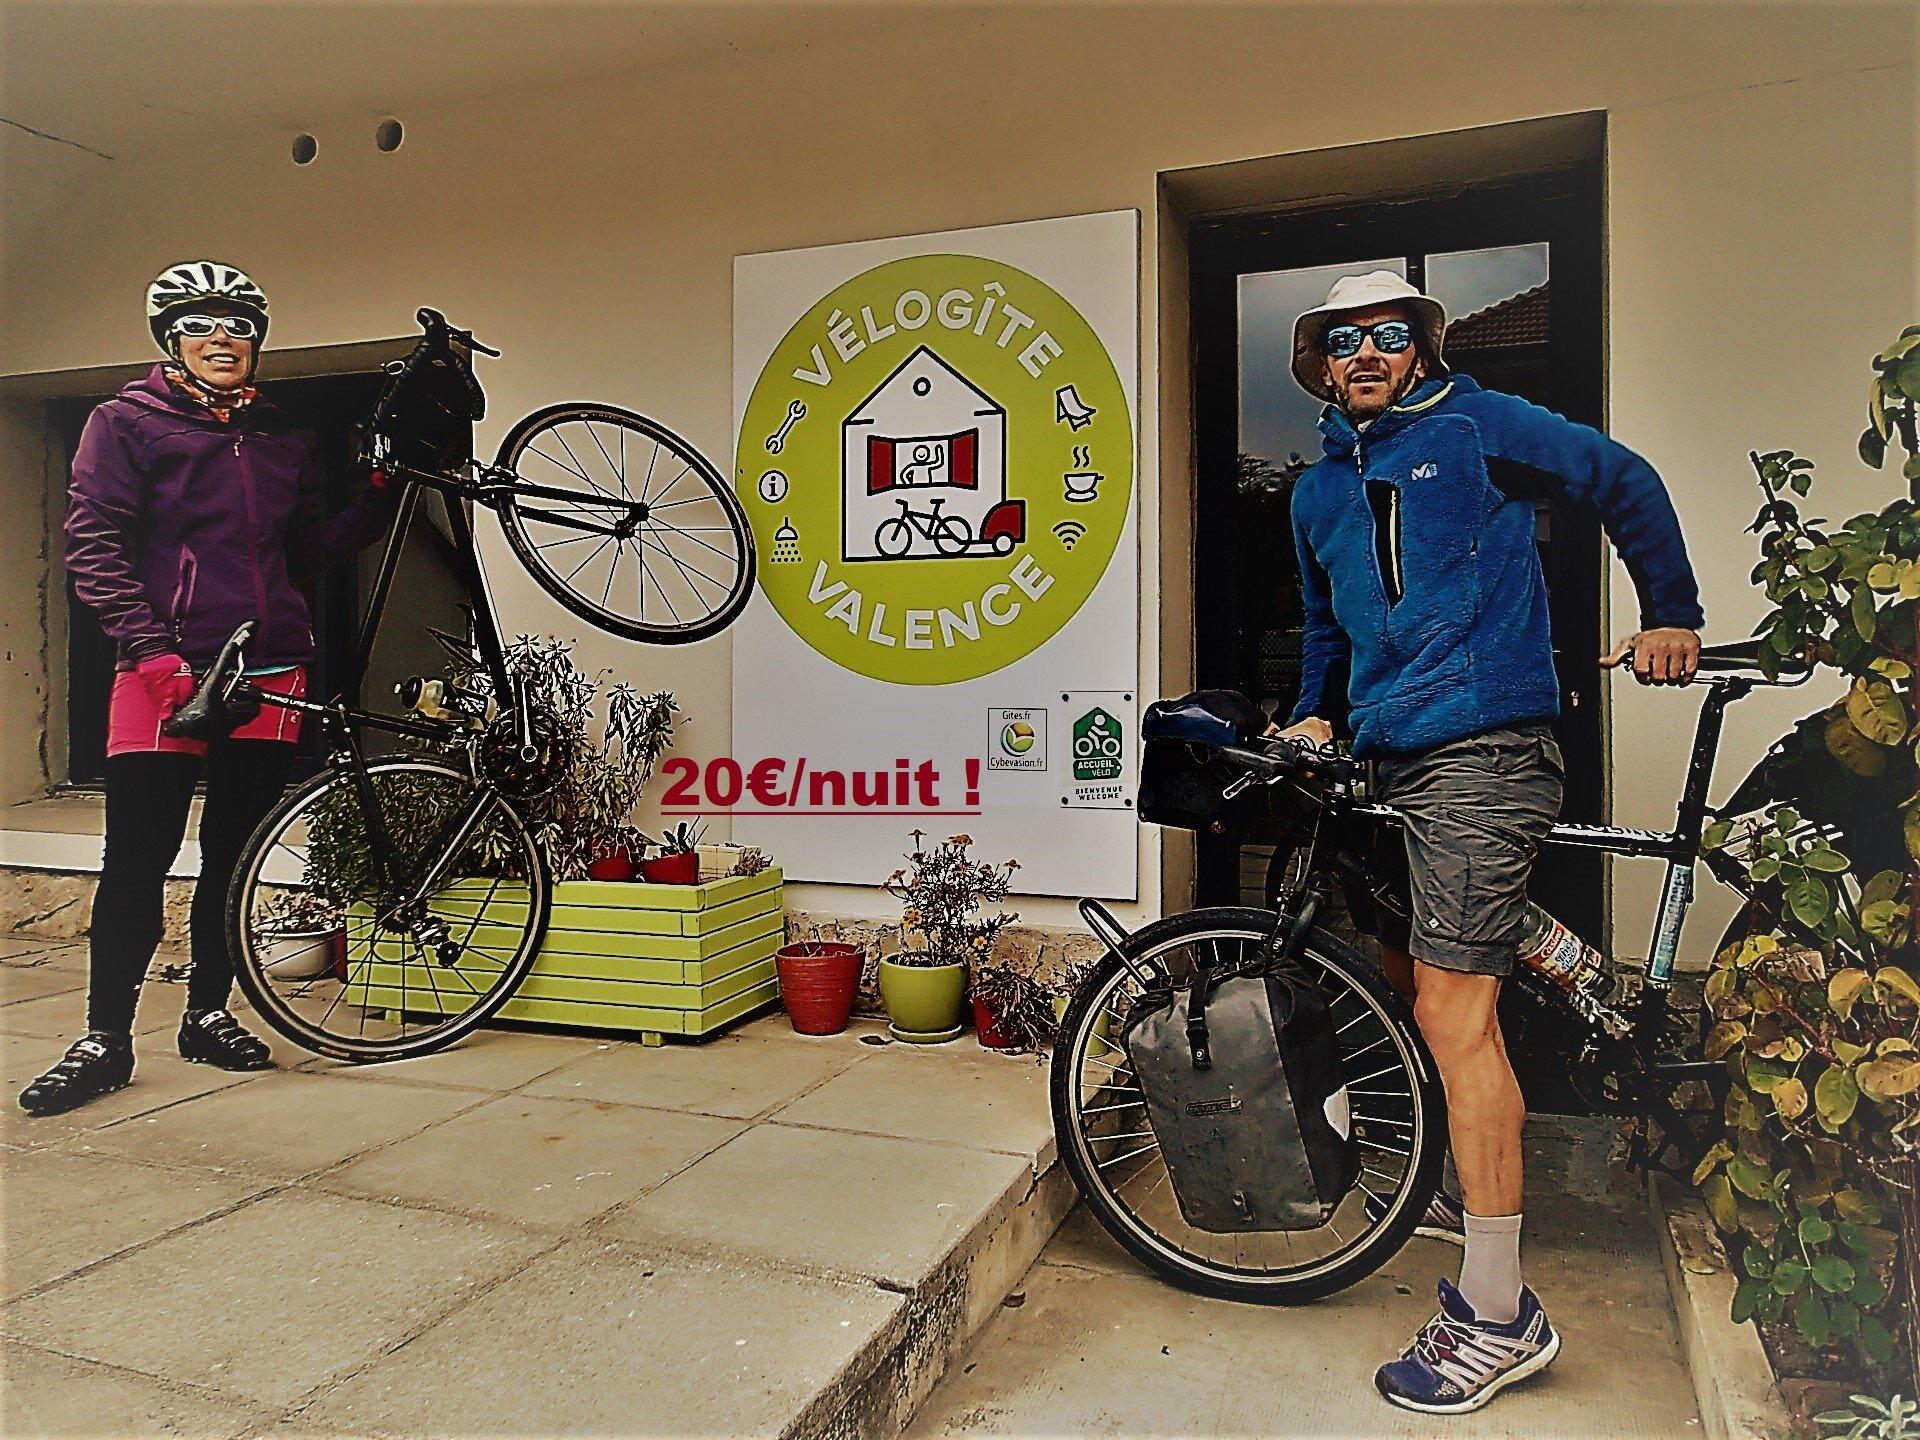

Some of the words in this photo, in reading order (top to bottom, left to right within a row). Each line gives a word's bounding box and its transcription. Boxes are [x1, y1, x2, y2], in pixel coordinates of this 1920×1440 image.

[792, 281, 1064, 388] VÉLOGÎTE
[808, 554, 1055, 649] VALENCE
[1002, 710, 1032, 720] Gites.fr
[990, 757, 1043, 768] Cybevasion.fr
[1077, 760, 1115, 770] ACCUEIL
[1075, 786, 1123, 795] BIENVENUE
[1079, 792, 1120, 801] WELCOME
